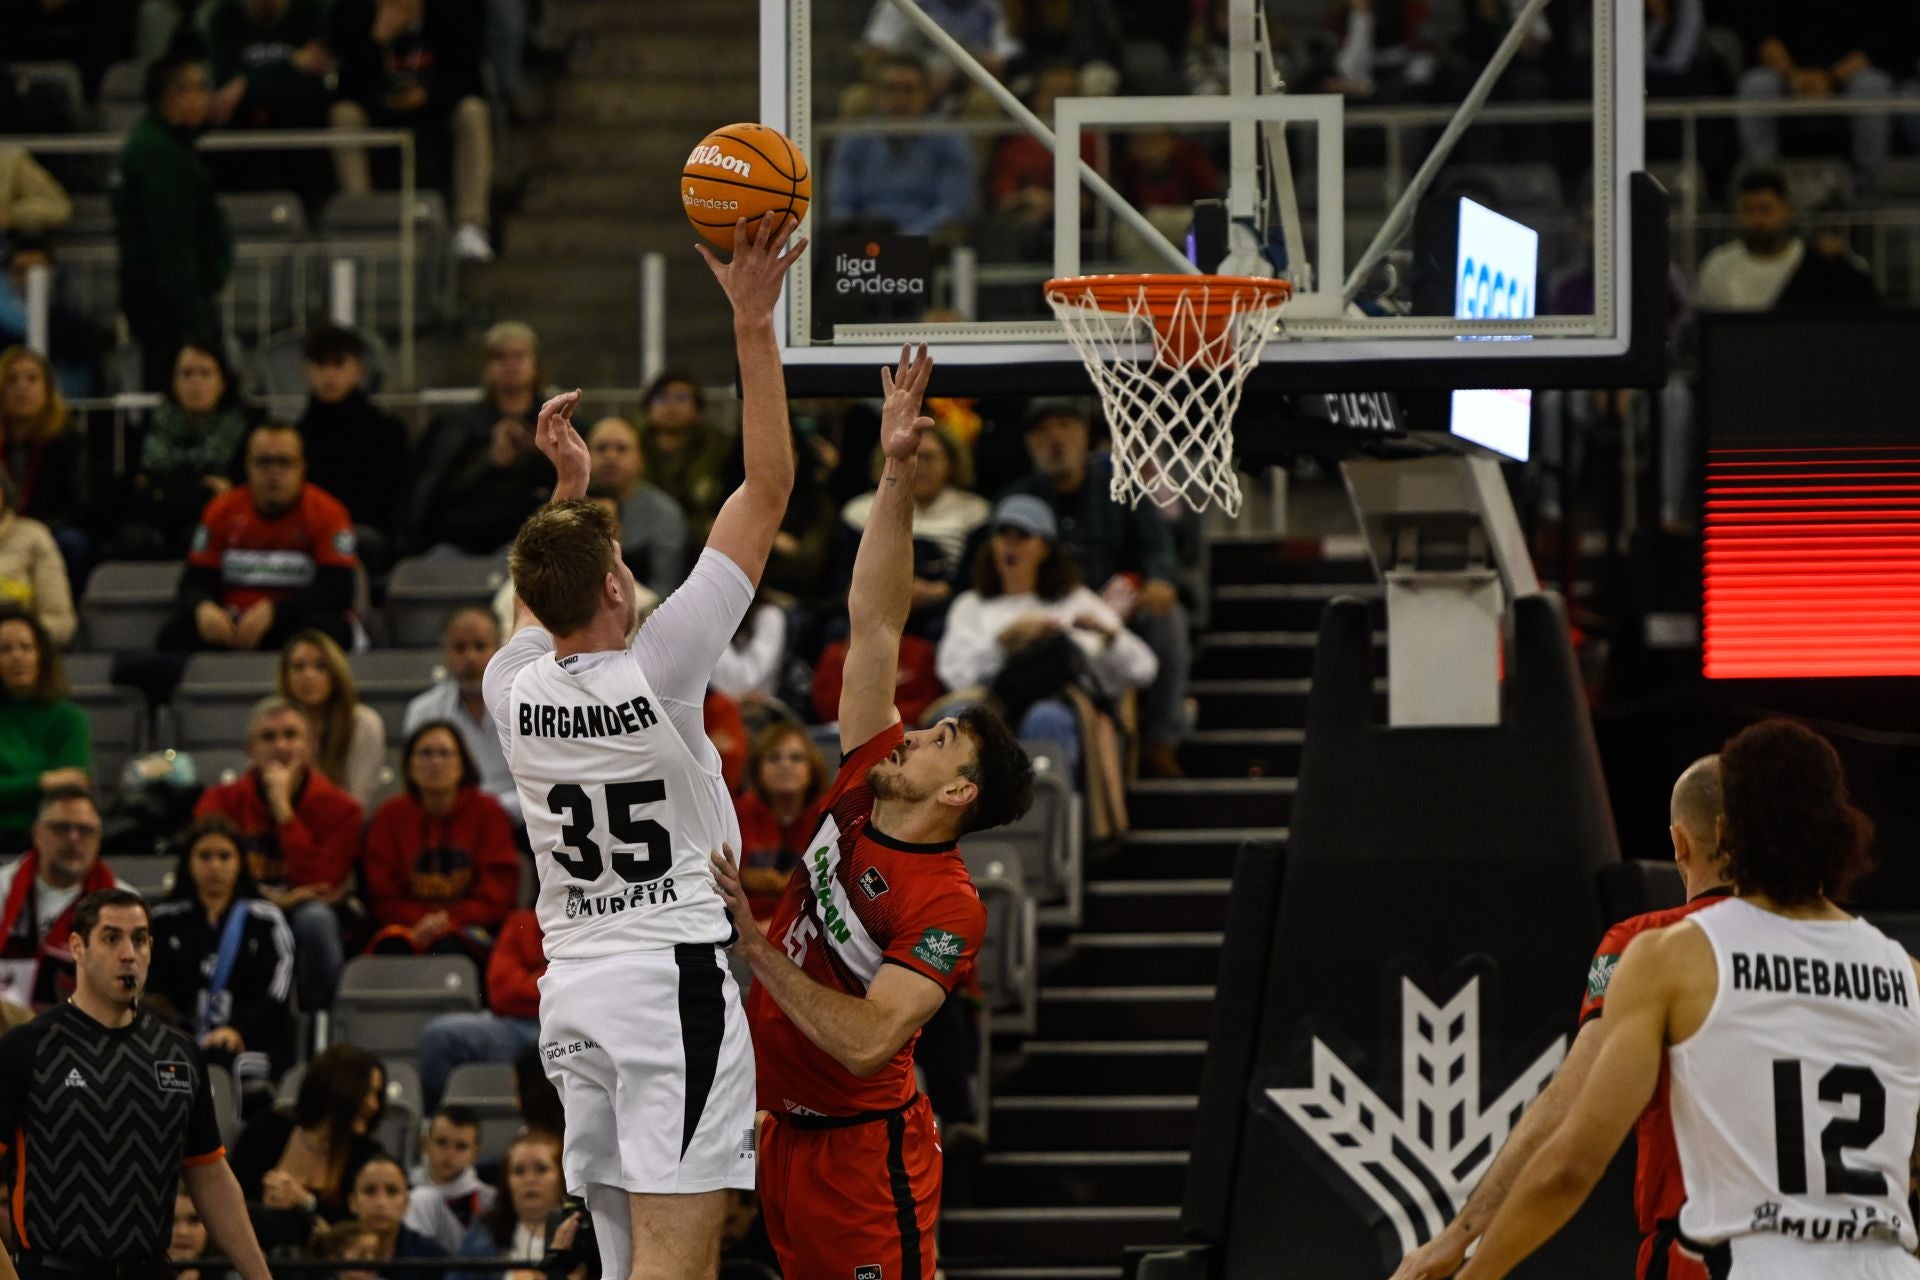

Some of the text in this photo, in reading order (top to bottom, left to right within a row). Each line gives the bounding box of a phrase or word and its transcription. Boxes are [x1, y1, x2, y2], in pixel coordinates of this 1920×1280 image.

[686, 145, 752, 178] Wilson
[836, 254, 876, 276] liga
[836, 274, 924, 294] endesa
[519, 696, 658, 738] BIRGANDER
[547, 779, 673, 884] 35
[579, 889, 678, 915] MURCIA
[1732, 952, 1908, 1008] RADEBAUGH
[568, 1042, 582, 1054] DE
[1773, 1059, 1889, 1197] 12
